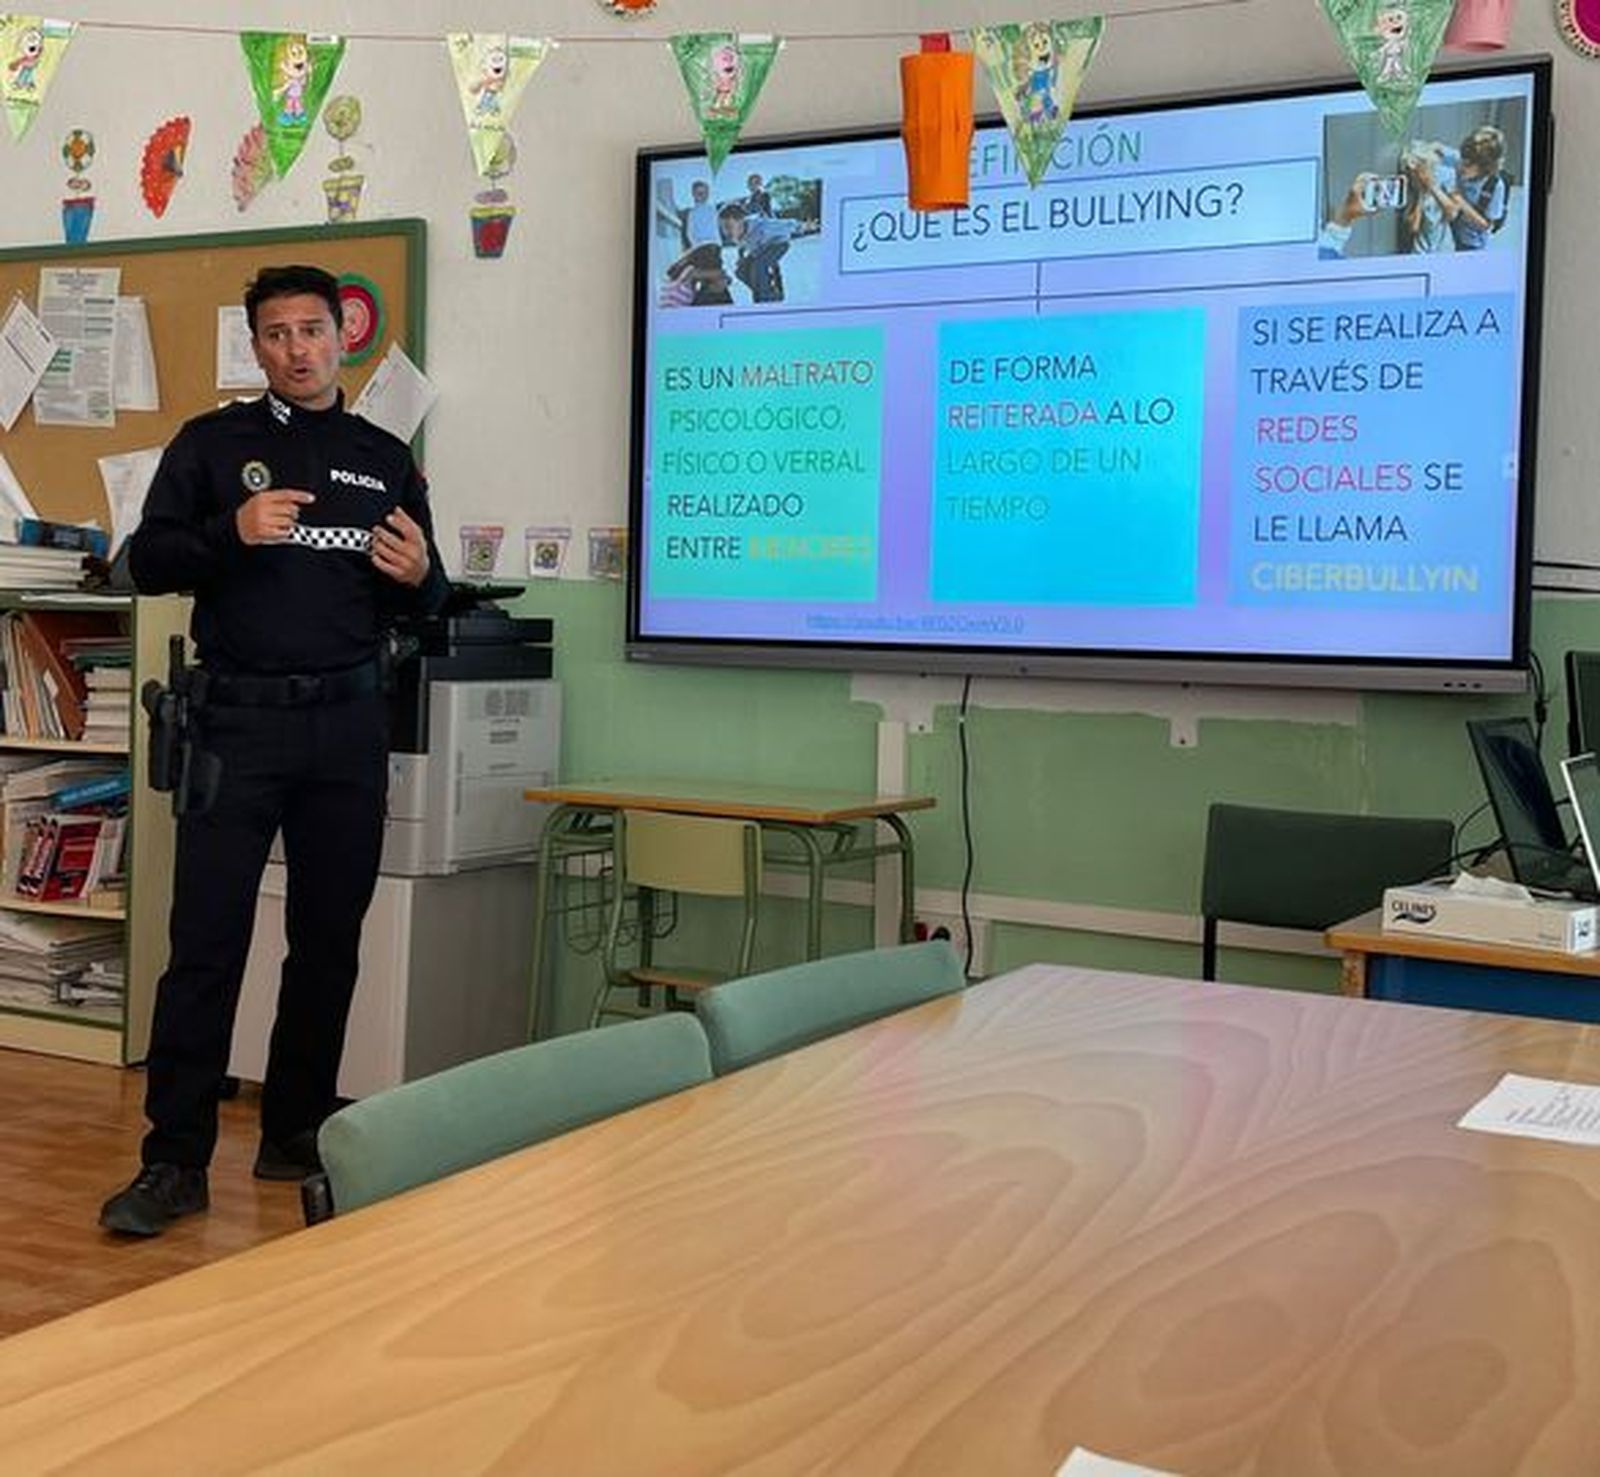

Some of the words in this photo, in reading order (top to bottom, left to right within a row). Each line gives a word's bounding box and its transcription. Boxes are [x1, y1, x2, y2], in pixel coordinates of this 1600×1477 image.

[952, 204, 990, 237] ES
[1003, 200, 1039, 233] EL
[1049, 182, 1244, 229] BULLYING?
[1253, 318, 1278, 346] SI
[1288, 316, 1324, 345] SE
[1335, 310, 1467, 341] REALIZA
[1476, 308, 1501, 334] A
[665, 366, 693, 391] ES
[699, 367, 734, 389] UN
[741, 360, 873, 388] MALTRATO
[950, 358, 985, 384] DE
[995, 355, 1097, 382] FORMA
[1251, 359, 1369, 394] TRAVÉS
[1379, 362, 1423, 390] DE
[949, 402, 1099, 429] REITERADA
[1105, 401, 1126, 424] A
[1135, 398, 1175, 424] LO
[1257, 415, 1358, 444] REDES
[662, 447, 740, 476] FÍSICO
[746, 450, 767, 475] O
[773, 449, 866, 474] VERBAL
[949, 449, 1040, 475] LARGO
[1052, 449, 1090, 474] DE
[1100, 448, 1141, 473] UN
[1255, 464, 1412, 493] SOCIALES
[1424, 462, 1463, 491] SE
[667, 493, 804, 518] REALIZADO
[947, 496, 1049, 521] TIEMPO
[1254, 515, 1288, 542] LE
[1298, 514, 1408, 542] LLAMA
[666, 536, 742, 559] ENTRE
